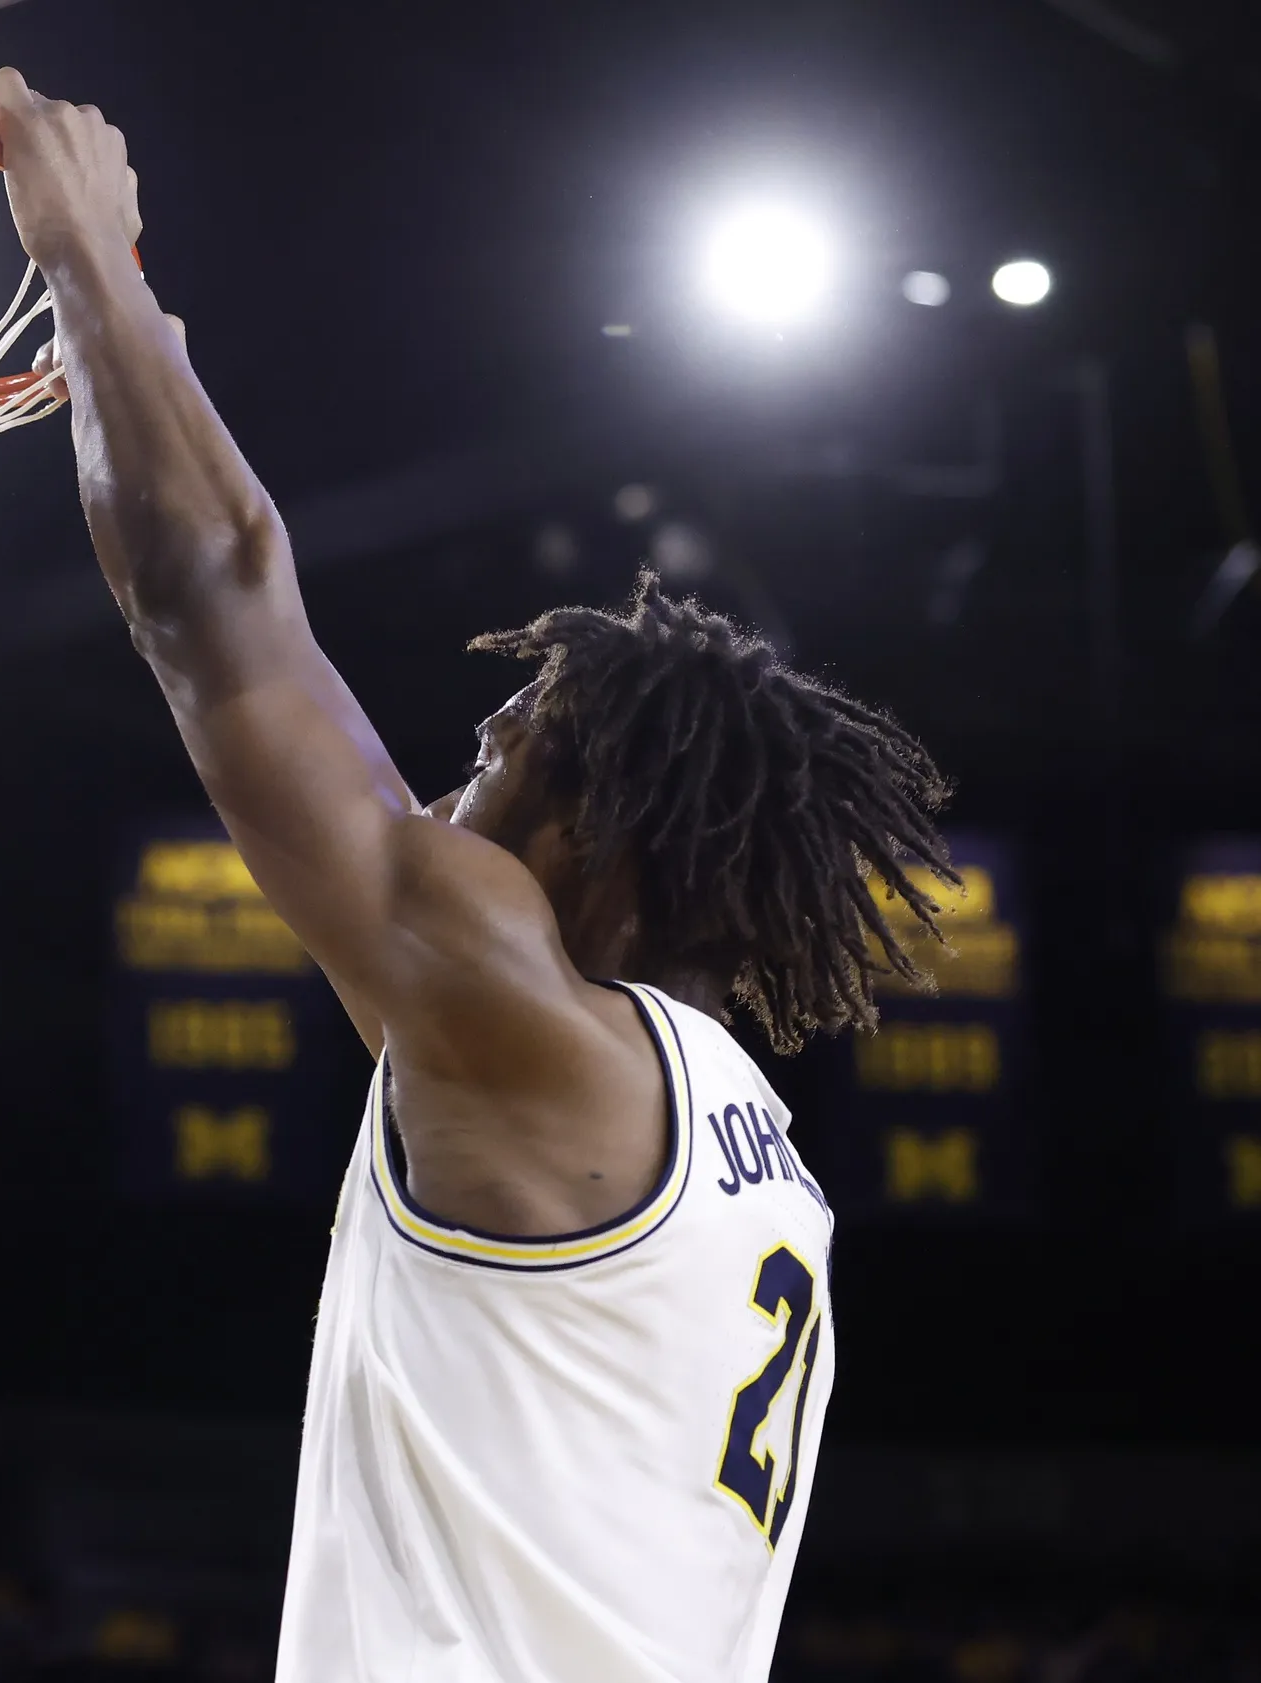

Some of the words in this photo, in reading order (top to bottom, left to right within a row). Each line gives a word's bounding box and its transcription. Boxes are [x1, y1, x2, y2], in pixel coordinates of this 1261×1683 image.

[177, 1108, 267, 1178] M
[707, 1101, 830, 1225] JOHN
[888, 1131, 976, 1199] M
[714, 1240, 821, 1557] 21
